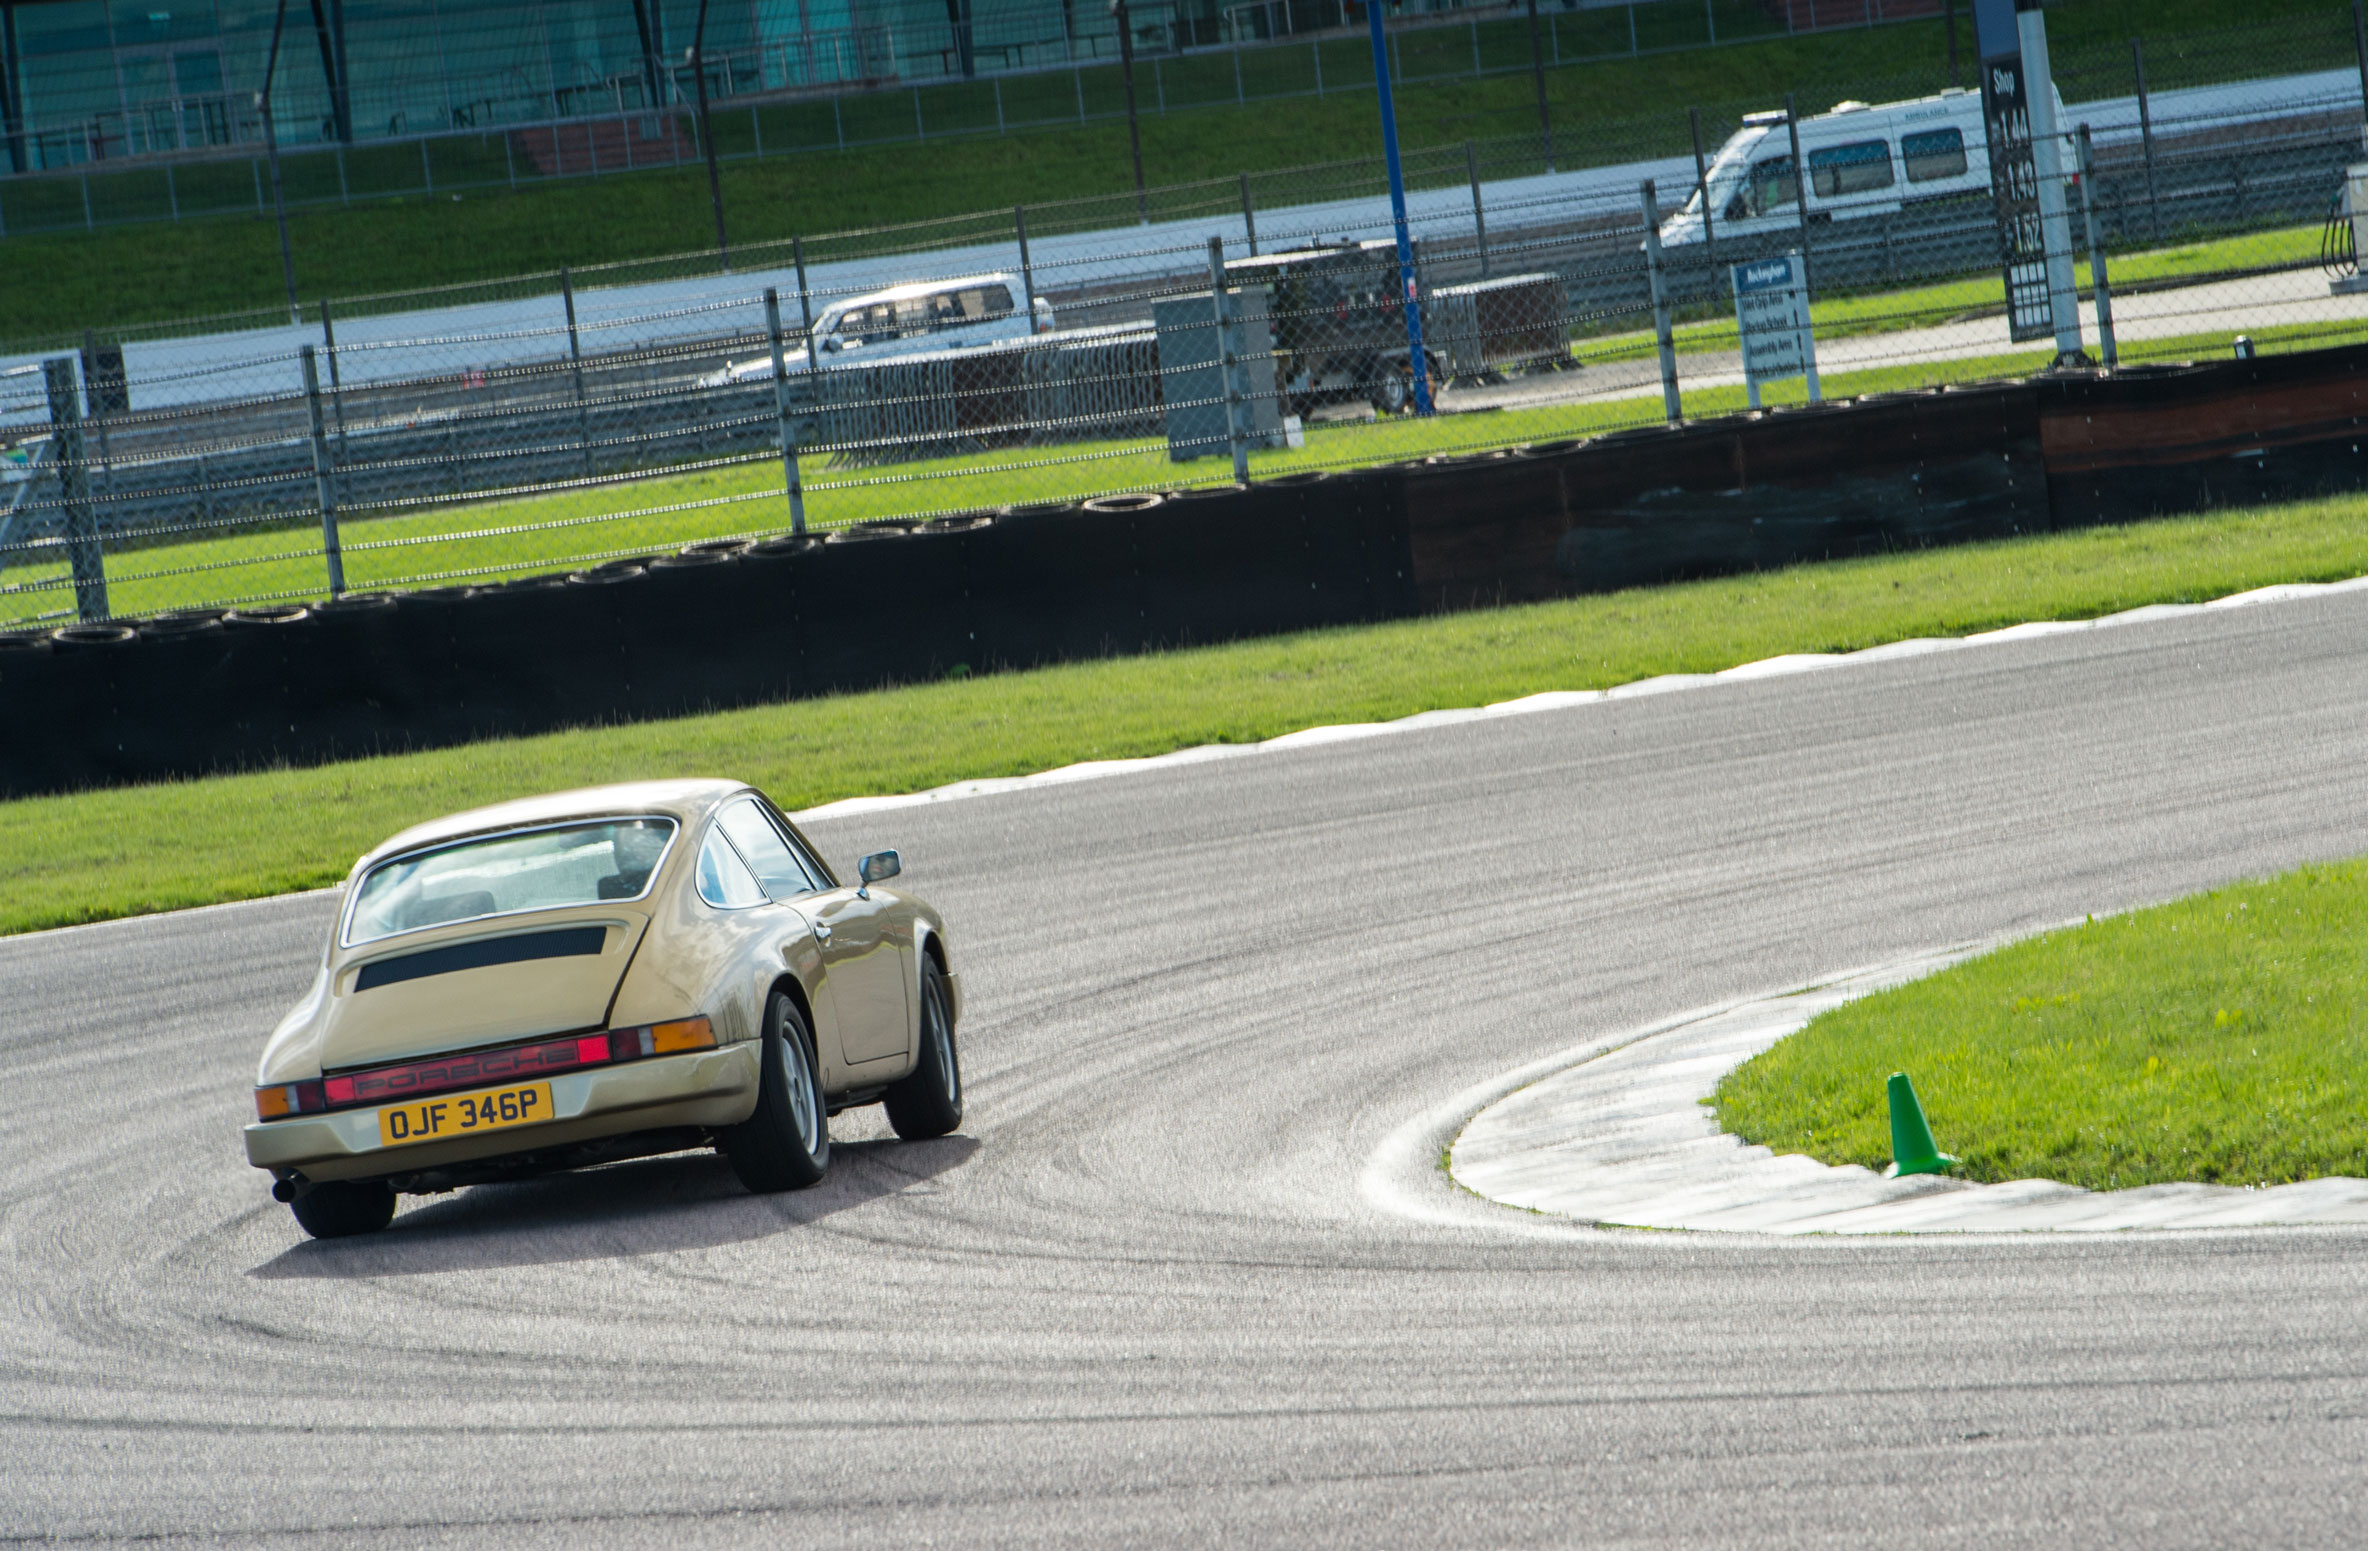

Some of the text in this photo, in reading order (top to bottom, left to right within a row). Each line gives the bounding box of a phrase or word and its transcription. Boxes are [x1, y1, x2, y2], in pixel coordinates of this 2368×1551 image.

[1993, 67, 2015, 97] Shop
[357, 1047, 577, 1095] PORSCHE
[389, 1088, 538, 1140] OJF 346P
